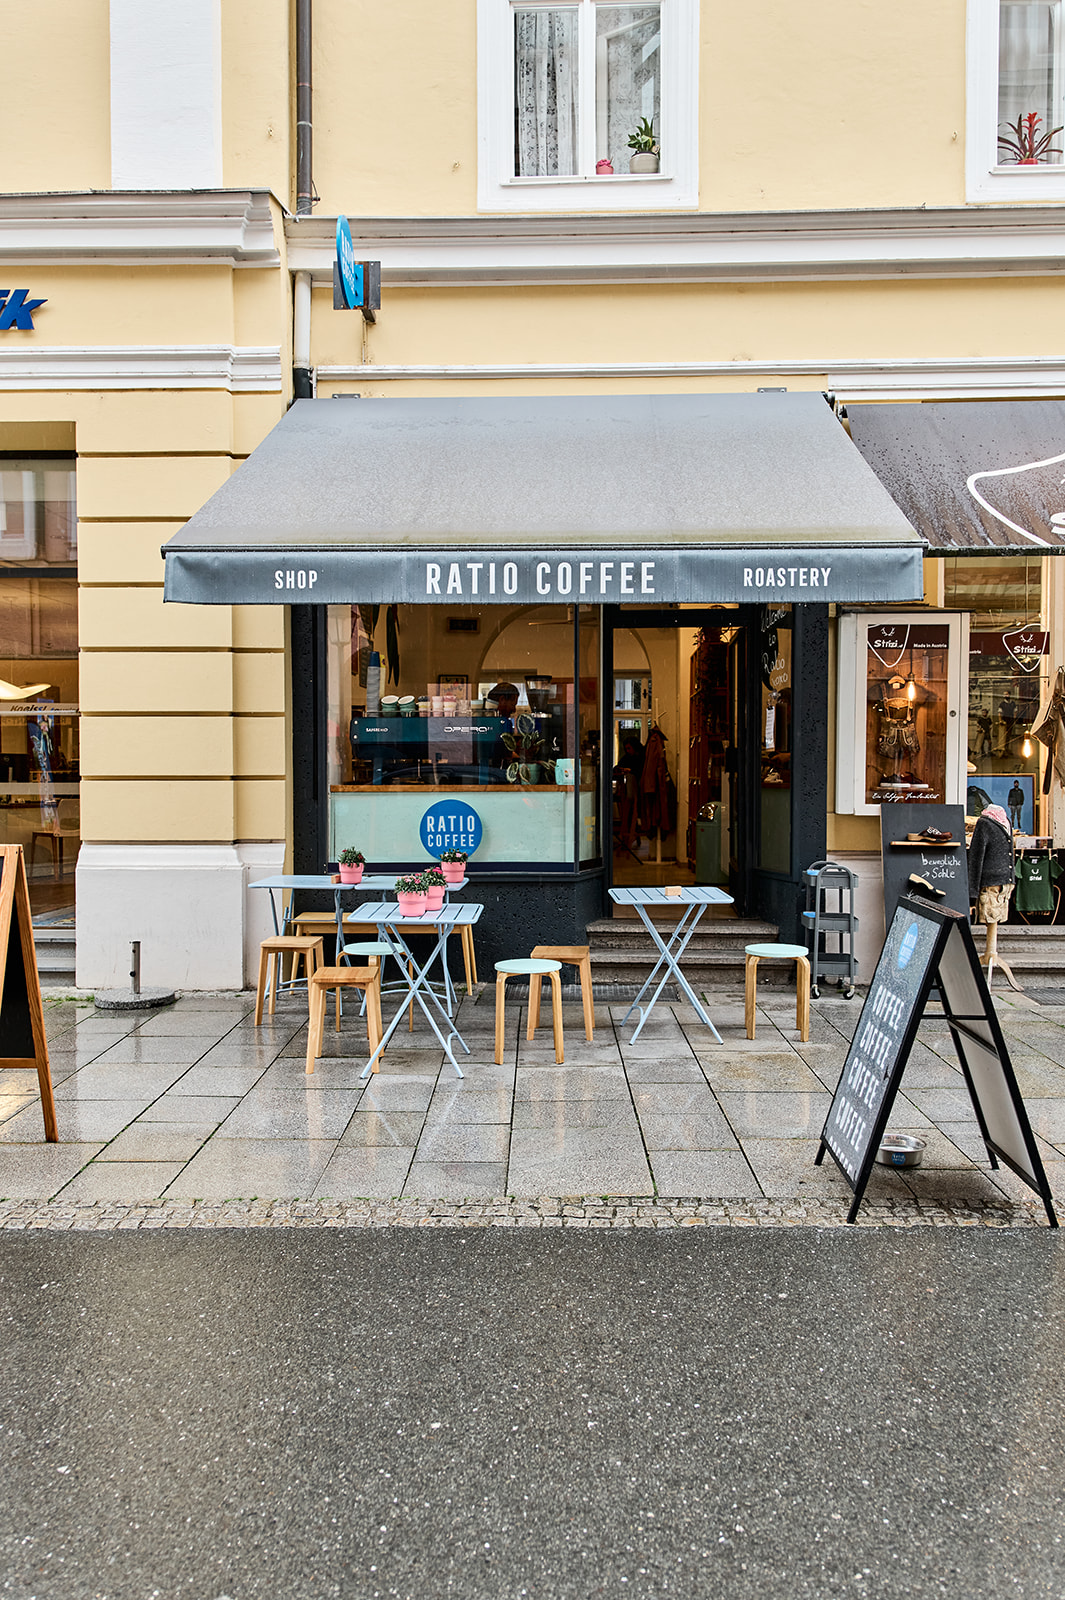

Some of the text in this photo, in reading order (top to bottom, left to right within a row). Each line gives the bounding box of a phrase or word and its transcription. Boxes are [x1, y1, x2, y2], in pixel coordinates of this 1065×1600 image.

[0, 289, 48, 330] k
[274, 570, 318, 589] SHOP
[426, 562, 656, 595] RATIO COFFEE
[743, 567, 832, 588] ROASTERY
[426, 815, 475, 832] RATIO
[427, 834, 475, 847] COFFEE
[872, 984, 904, 1031] COFFEE
[860, 1021, 892, 1069] COFFEE
[848, 1056, 879, 1110] COFFEE
[835, 1096, 866, 1152] COFFEE
